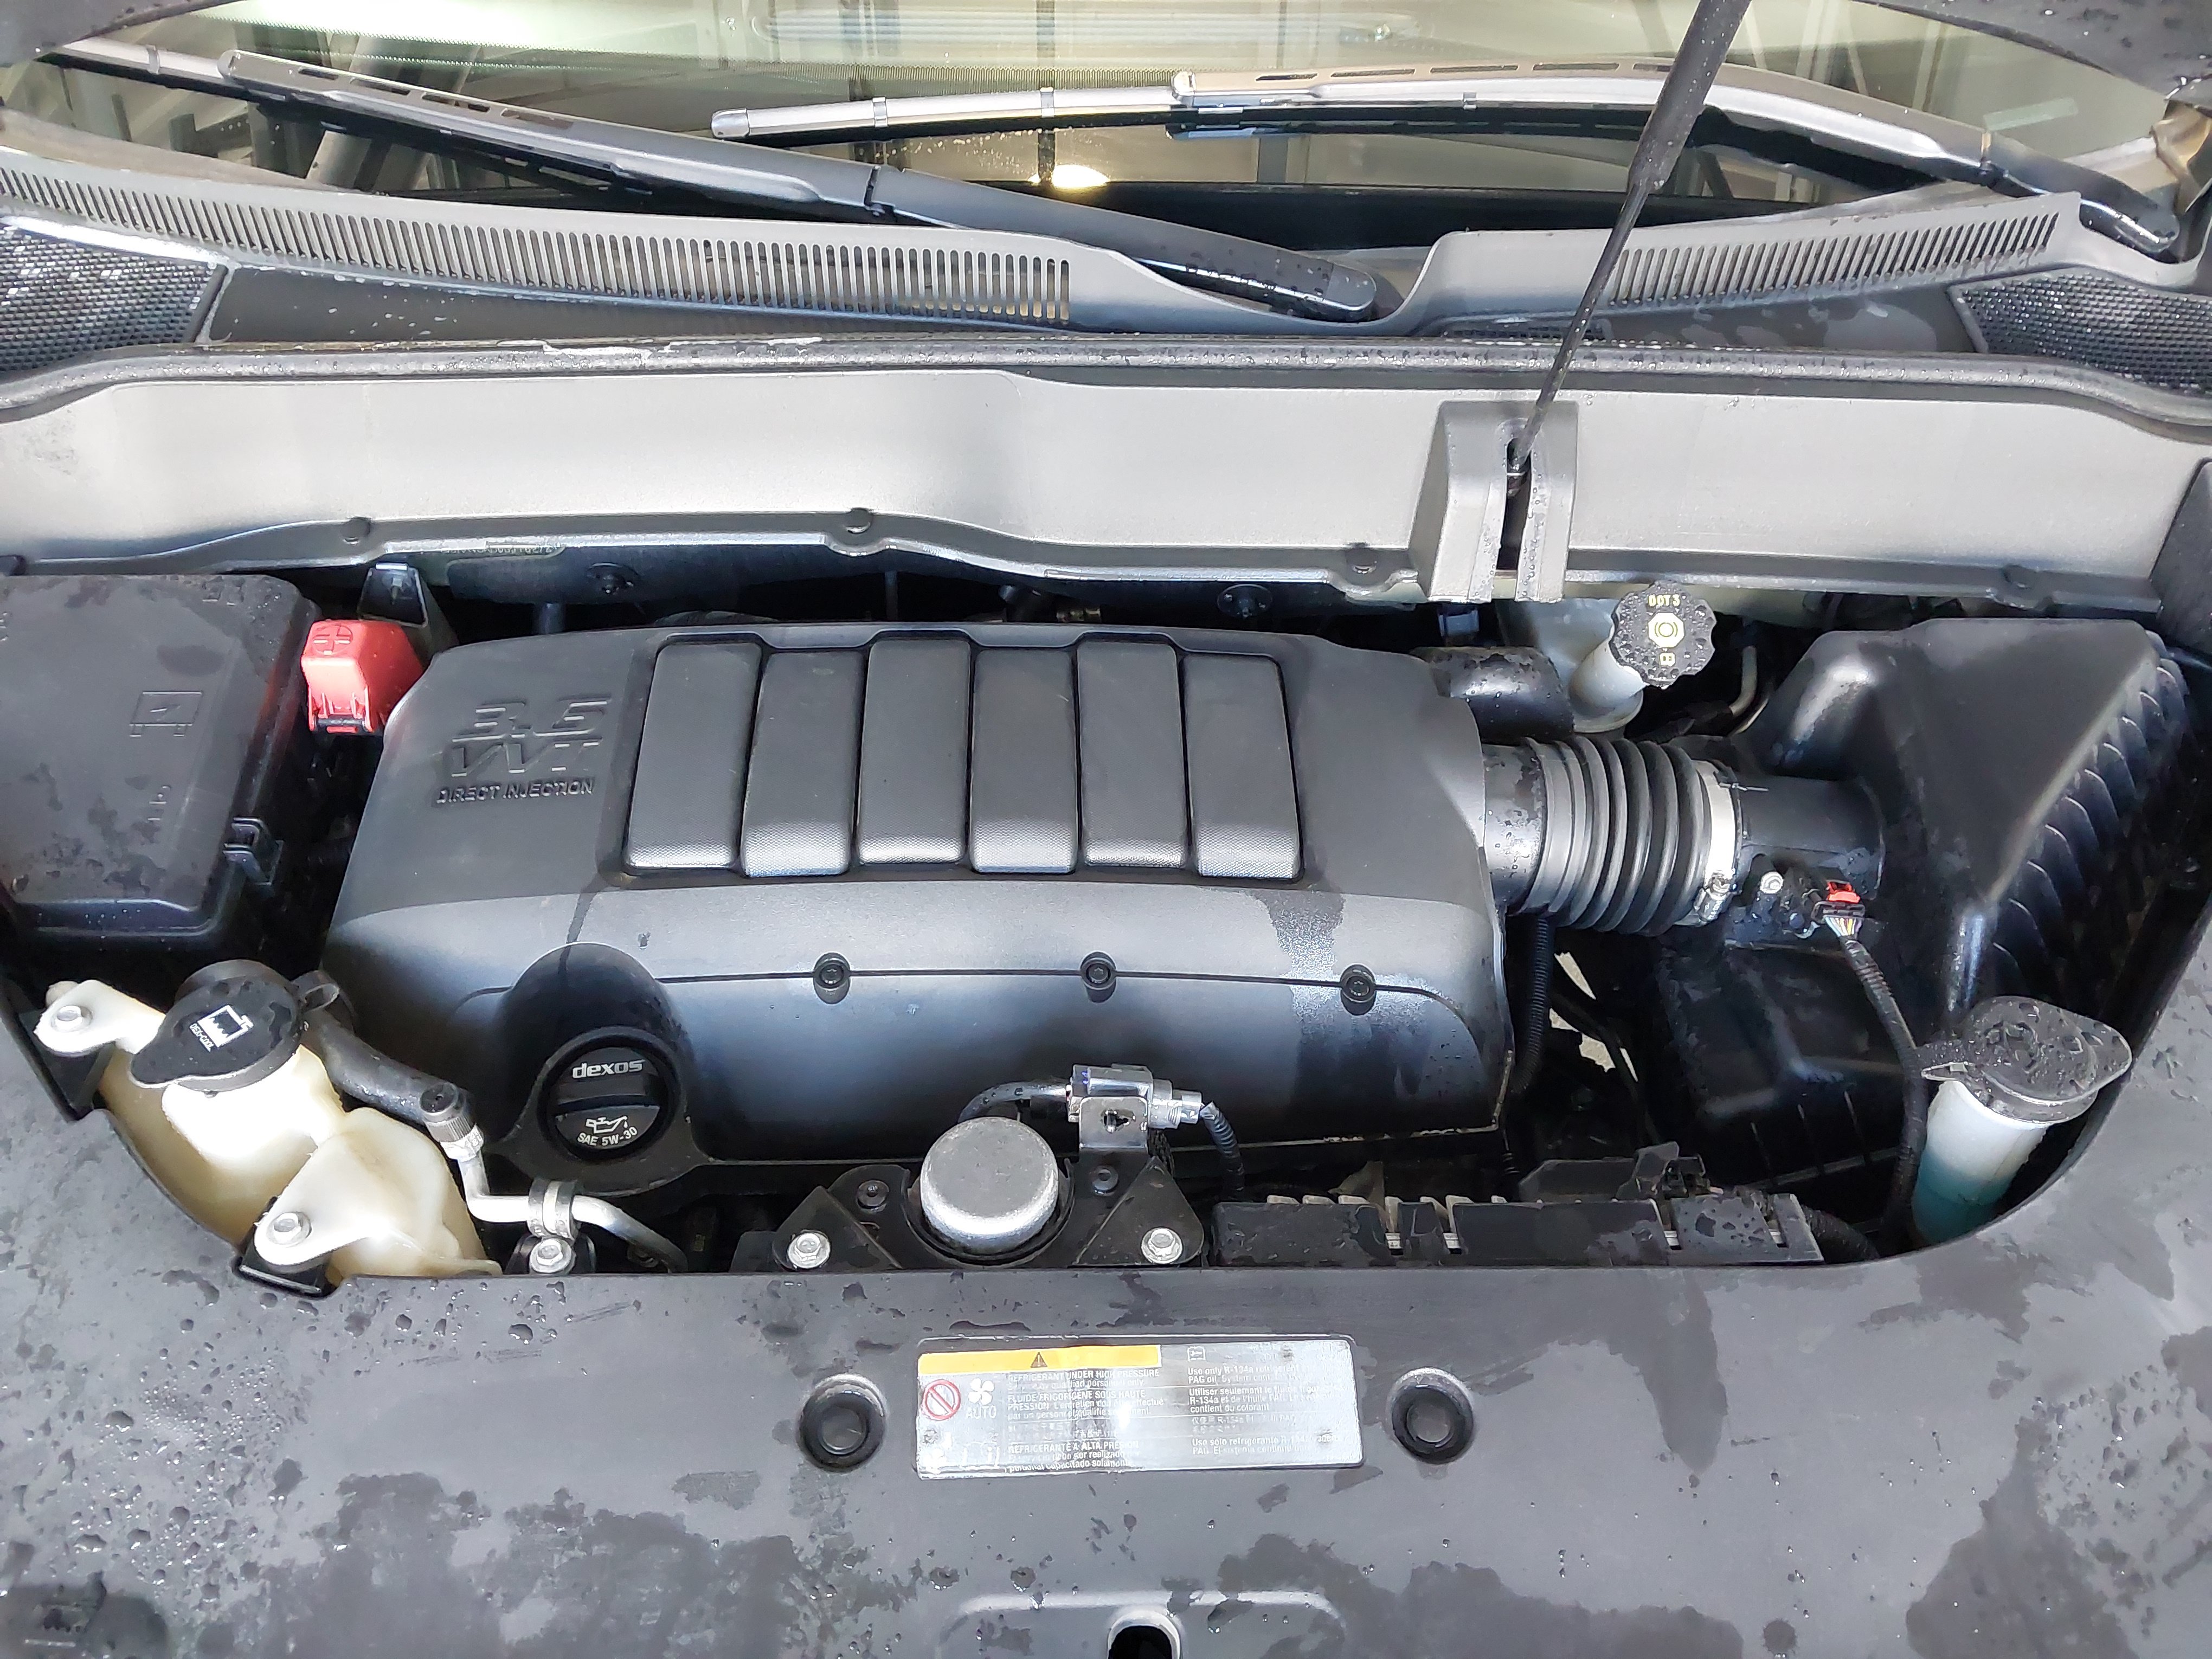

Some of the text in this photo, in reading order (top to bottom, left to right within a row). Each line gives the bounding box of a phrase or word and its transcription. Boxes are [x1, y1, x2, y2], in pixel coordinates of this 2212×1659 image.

[1648, 594, 1680, 608] DOT 3
[435, 777, 595, 805] DIRECT INJECTION
[573, 1059, 646, 1078] dexos
[577, 1126, 638, 1147] SAE 5W-30
[1065, 1369, 1094, 1380] UNDER
[1117, 1368, 1160, 1378] PRESSURE
[1205, 1366, 1222, 1376] only
[1188, 1375, 1205, 1384] PAG
[1094, 1390, 1116, 1399] SOUS
[1118, 1390, 1146, 1398] HAUTE
[1189, 1387, 1218, 1396] Utiliser
[1189, 1396, 1219, 1405] R-134a
[966, 1404, 997, 1419] AUTO
[1190, 1405, 1222, 1413] contient
[1008, 1442, 1072, 1455] REFRIGERANTE
[1081, 1441, 1102, 1451] ALTA
